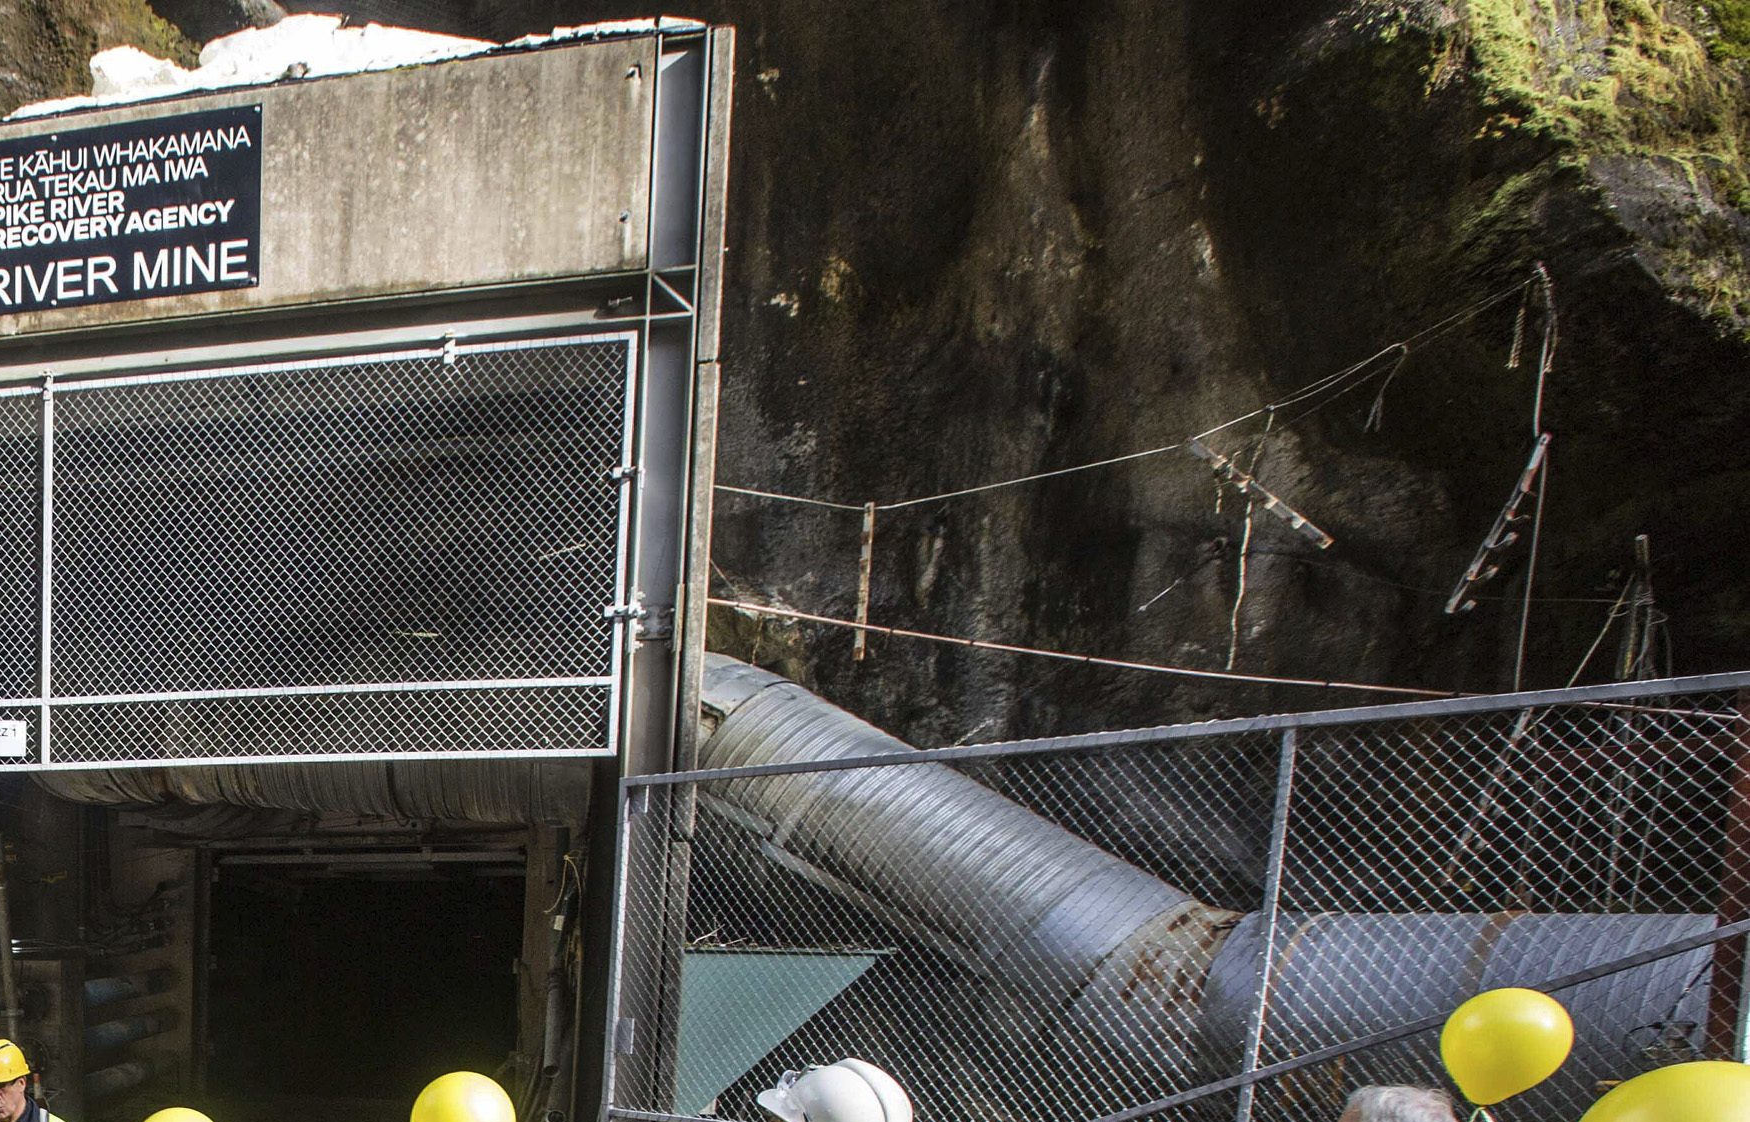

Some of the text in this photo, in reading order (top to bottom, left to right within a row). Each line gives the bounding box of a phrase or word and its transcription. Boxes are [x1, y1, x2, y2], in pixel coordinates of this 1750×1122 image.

[19, 148, 88, 178] KĀHUI
[93, 125, 251, 168] WHAKAMANA
[38, 167, 117, 199] TEKAU
[122, 162, 160, 188] MA
[164, 155, 208, 183] IWA
[50, 190, 125, 221] RIVER
[124, 198, 235, 235] AGENCY
[132, 238, 249, 291] MINE
